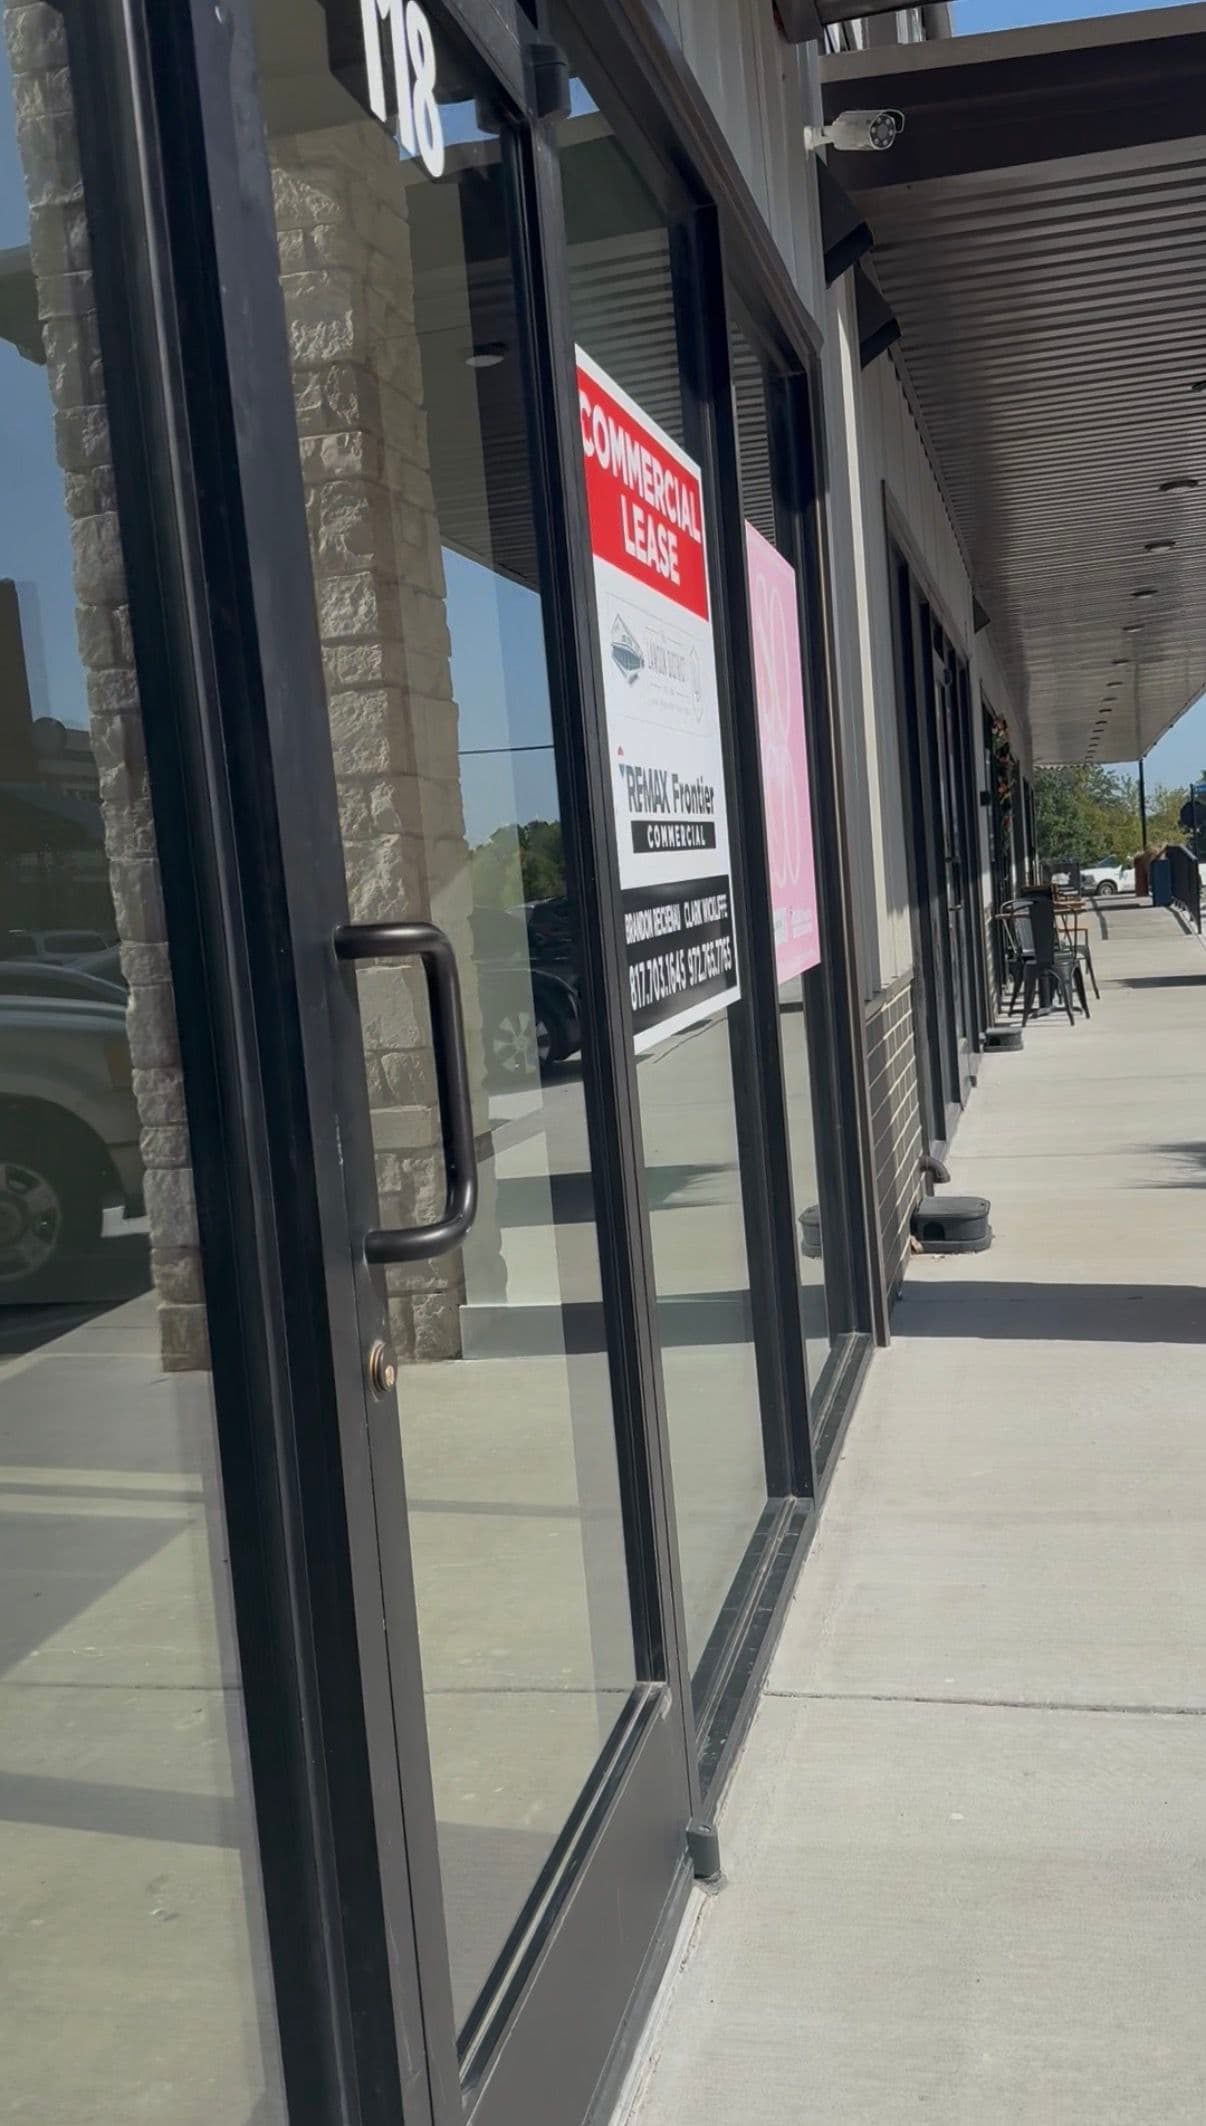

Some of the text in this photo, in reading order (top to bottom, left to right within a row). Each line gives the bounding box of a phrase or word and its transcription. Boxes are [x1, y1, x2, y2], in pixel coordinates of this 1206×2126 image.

[578, 389, 702, 544] COMMERCIAL
[620, 493, 681, 586] LEASE
[672, 773, 714, 815] Frontier
[646, 823, 706, 849] COMMERCIAL
